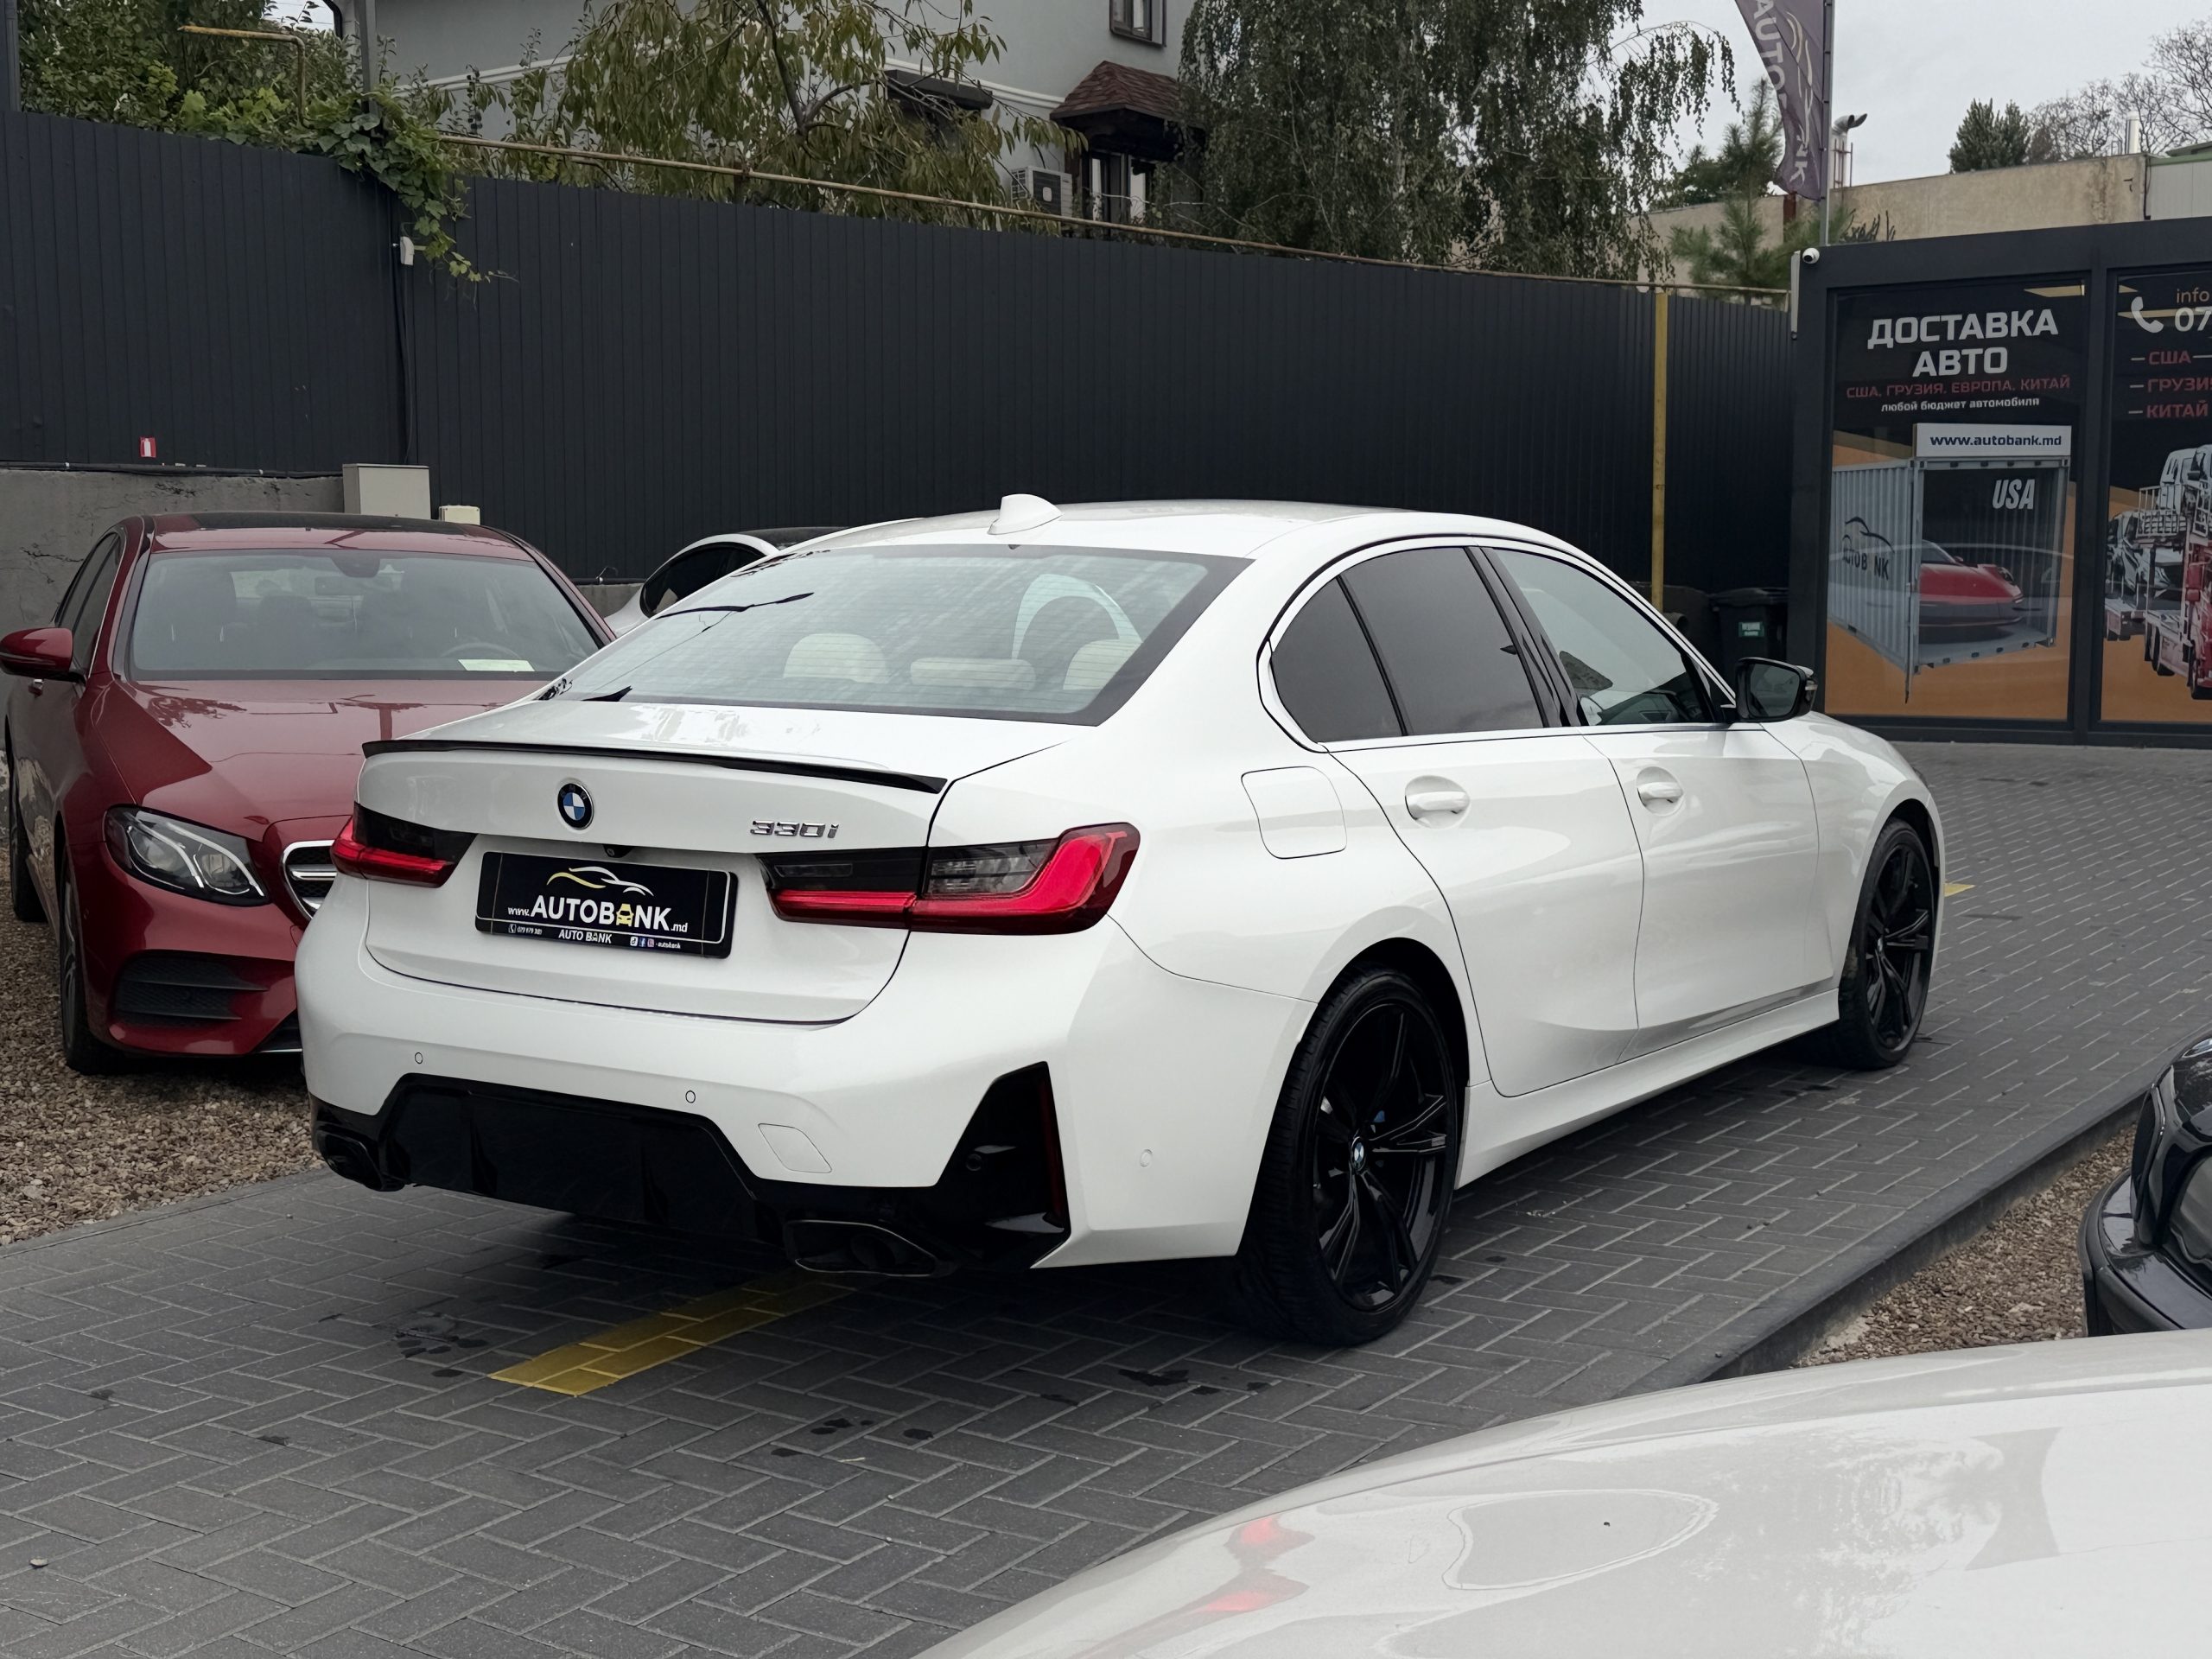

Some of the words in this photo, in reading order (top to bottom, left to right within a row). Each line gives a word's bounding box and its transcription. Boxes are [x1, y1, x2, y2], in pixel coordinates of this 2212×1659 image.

[1866, 308, 2059, 350] ДОСТАВКА
[1911, 346, 2008, 378] АВТО
[2148, 350, 2192, 365] США
[2020, 374, 2071, 391] КИТАЙ
[2146, 377, 2212, 393] ГРУЗИ
[1881, 400, 1918, 413] любой
[1920, 399, 1967, 411] бюджет
[1968, 396, 2041, 408] автомобиля
[2145, 400, 2209, 419] КИТАЙ
[1929, 434, 2063, 447] www.autobank.md
[1992, 478, 2036, 511] USA
[749, 821, 839, 839] 330i
[558, 929, 584, 941] AUTO
